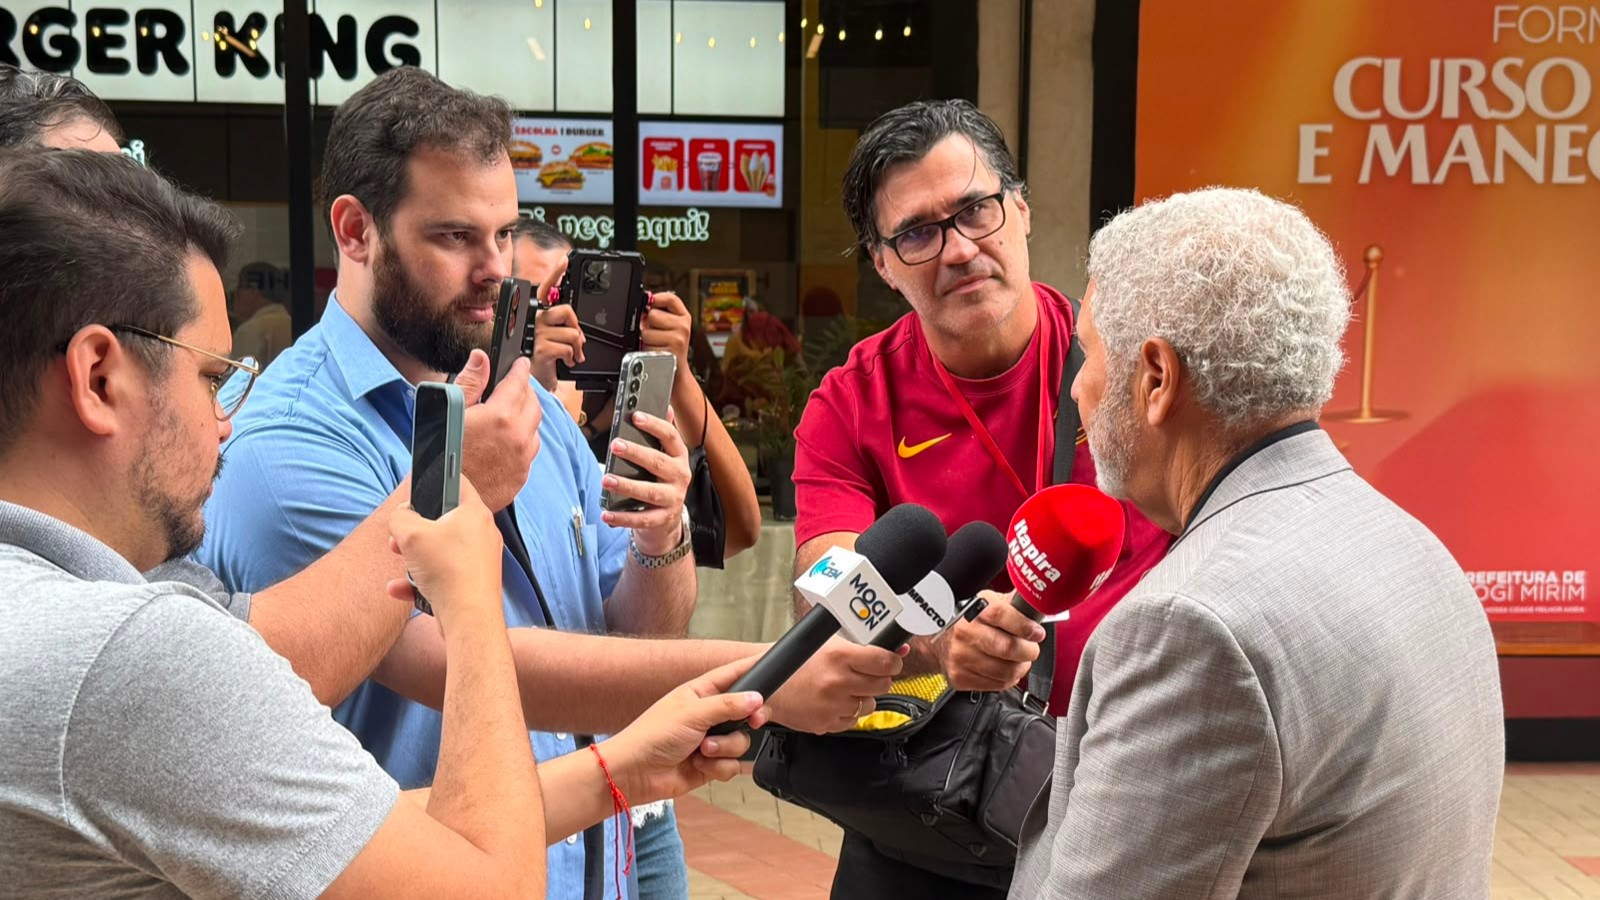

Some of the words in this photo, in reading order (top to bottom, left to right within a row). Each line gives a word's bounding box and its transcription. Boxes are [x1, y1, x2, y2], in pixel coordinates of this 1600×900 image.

[1333, 57, 1592, 120] CURSO
[515, 127, 558, 136] ESCOLHA
[566, 128, 605, 136] BURGER
[1297, 124, 1333, 184] E
[1358, 124, 1600, 184] MANE
[557, 214, 614, 248] peç
[637, 207, 710, 248] aqui!
[1008, 537, 1047, 592] News
[1013, 518, 1061, 583] Itapira
[849, 573, 891, 622] MOGI
[1464, 570, 1559, 585] REFEITURA
[1562, 570, 1586, 585] DE
[1473, 584, 1513, 602] OGI
[1520, 583, 1585, 602] MIRIM
[907, 588, 946, 628] MPACTO
